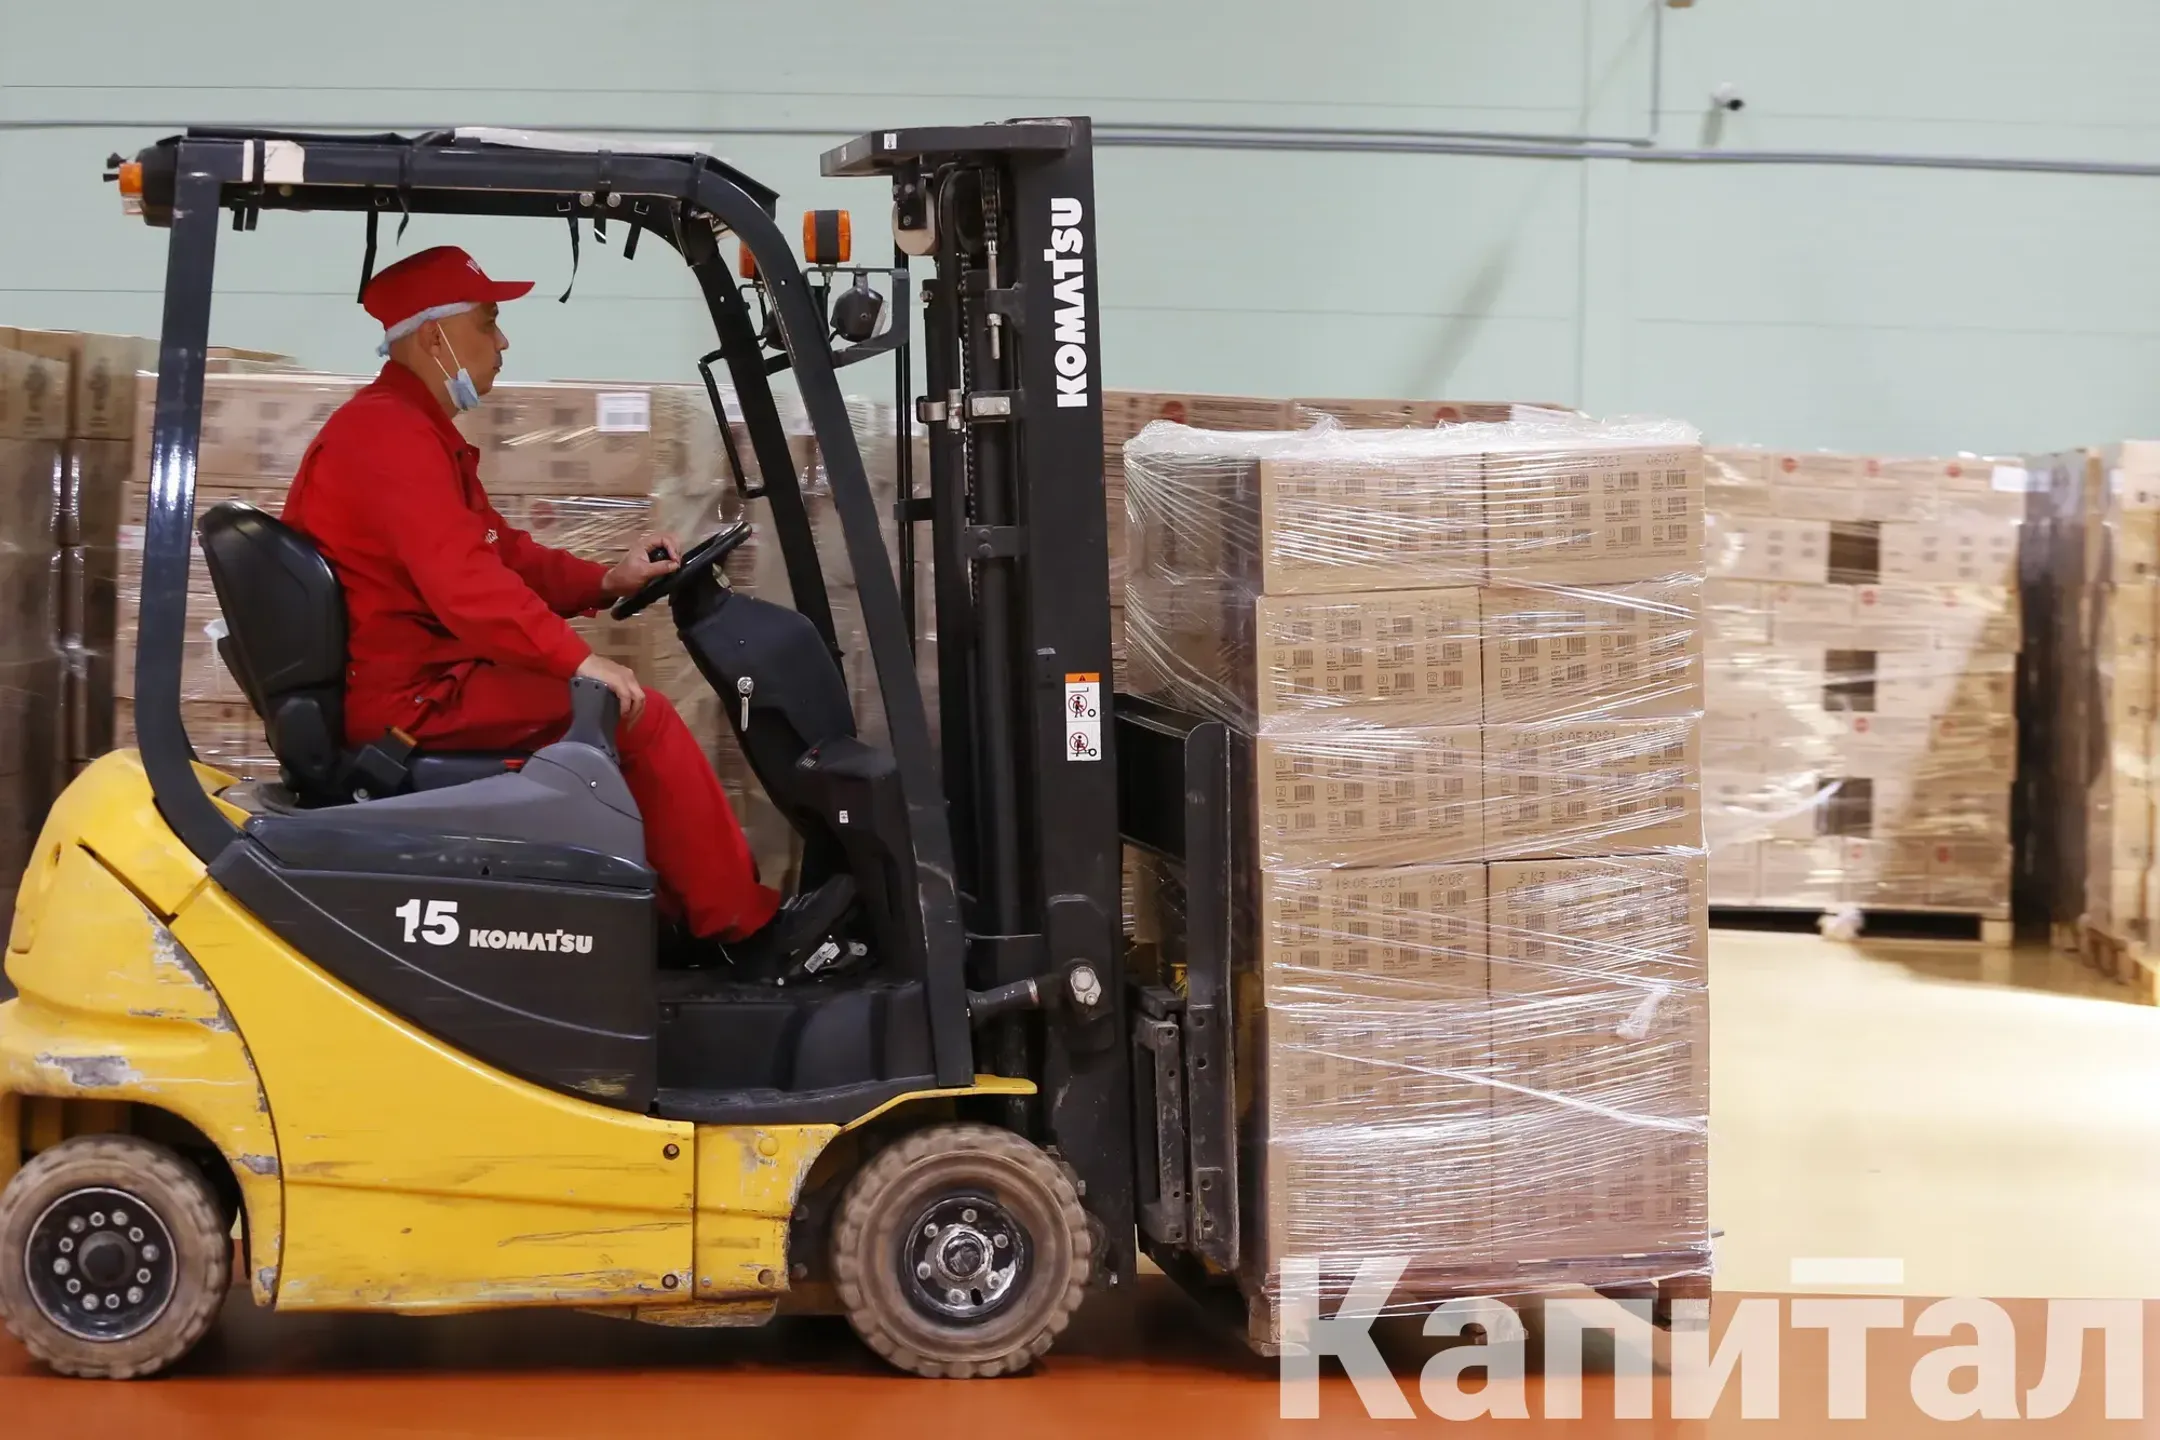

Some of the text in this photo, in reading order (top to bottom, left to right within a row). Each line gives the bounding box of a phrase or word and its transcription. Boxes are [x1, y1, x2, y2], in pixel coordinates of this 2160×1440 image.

[1044, 197, 1088, 408] KOMATSU
[396, 898, 593, 954] 15 KOMATSU
